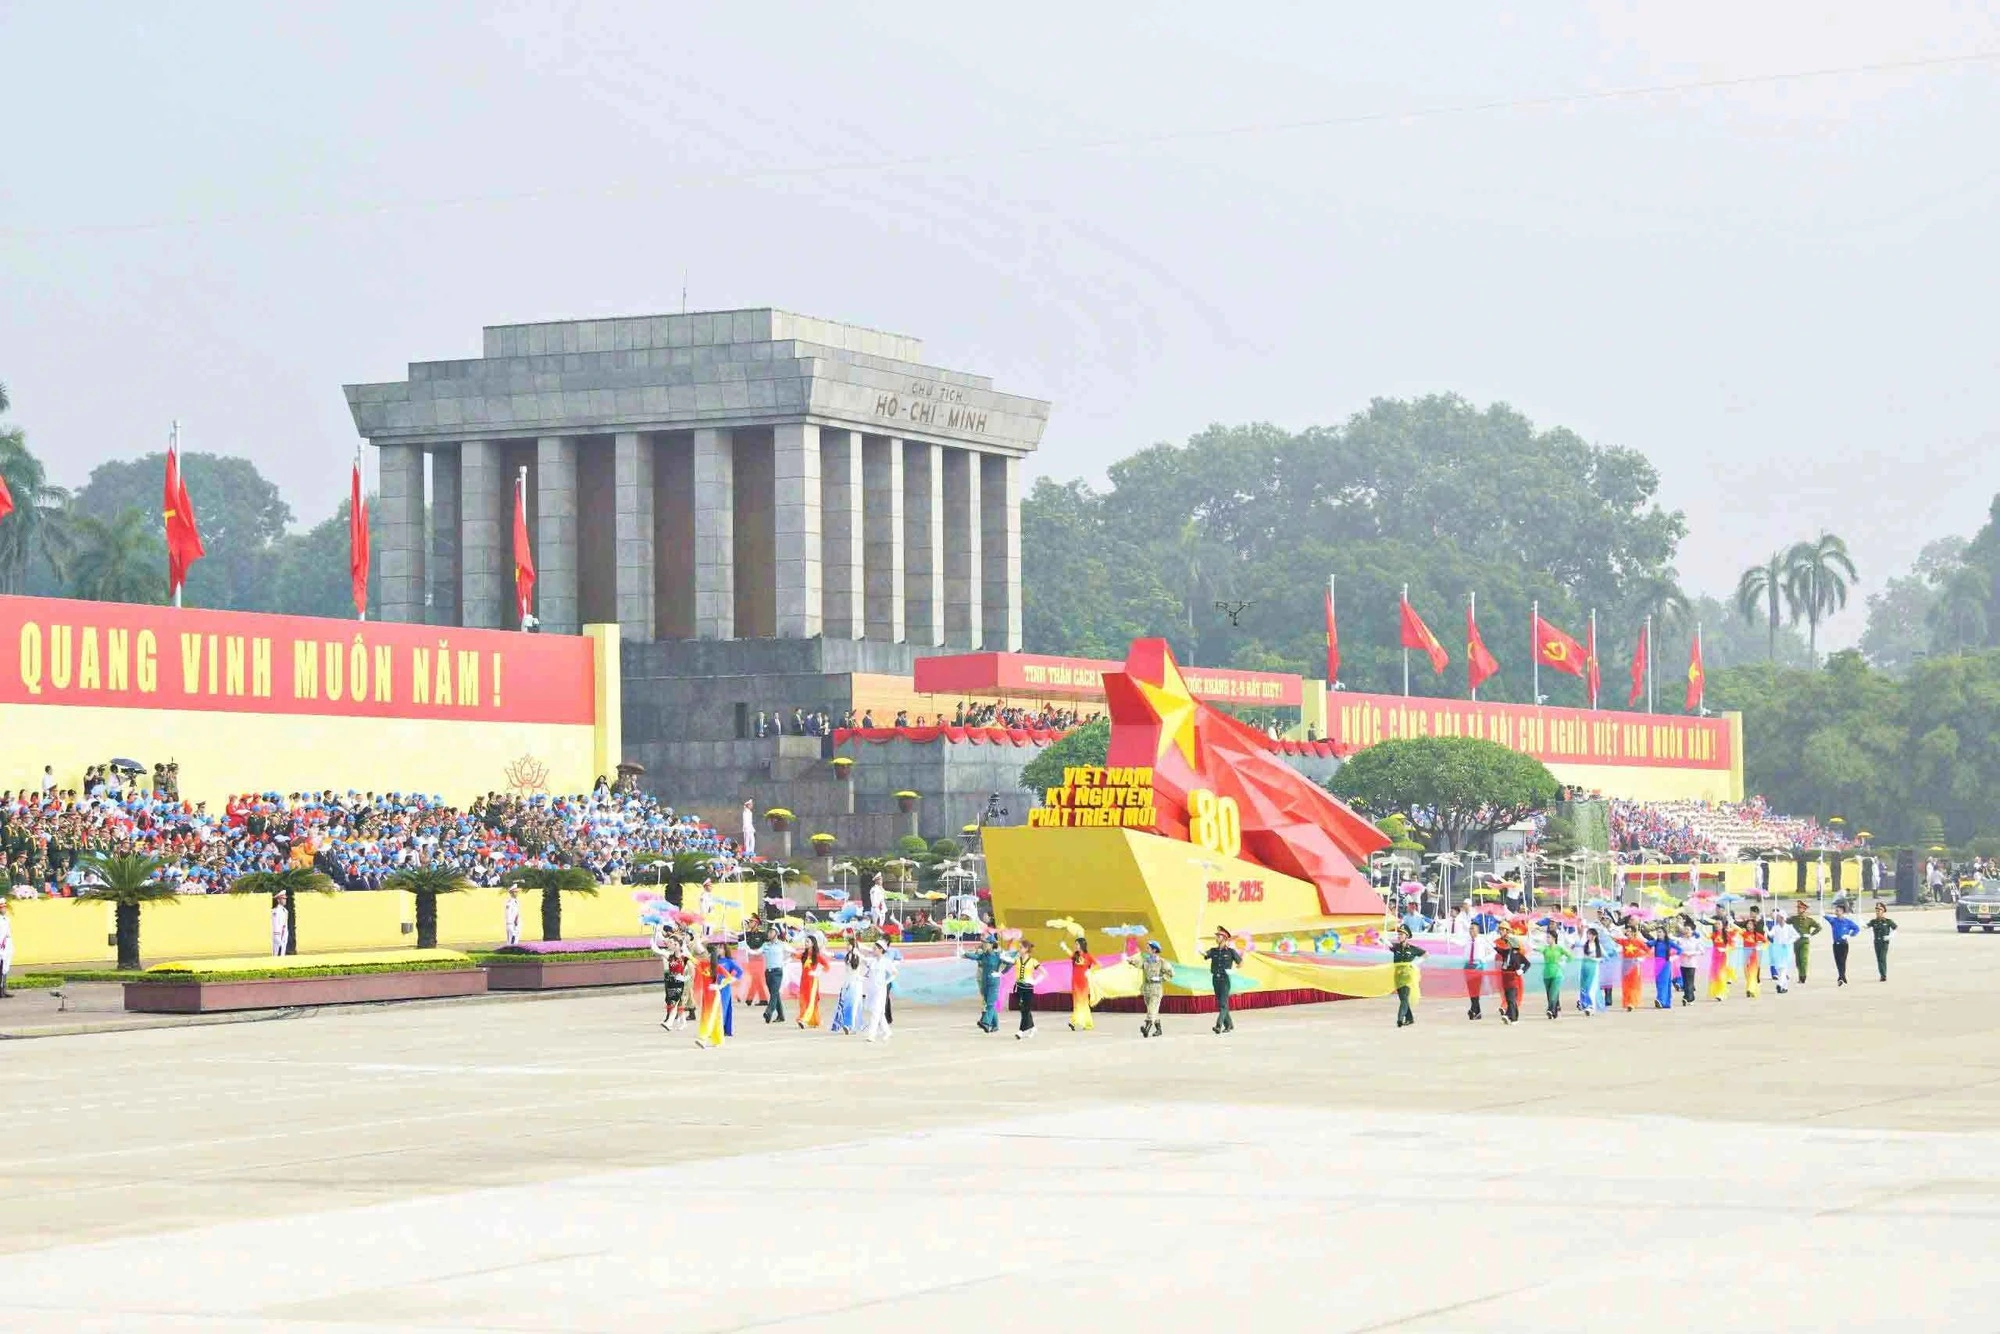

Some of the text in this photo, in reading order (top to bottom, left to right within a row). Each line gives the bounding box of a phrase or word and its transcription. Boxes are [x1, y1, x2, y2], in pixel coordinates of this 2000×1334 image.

[20, 621, 157, 695] QUANG
[180, 633, 271, 697] VINH
[294, 633, 392, 703] MUÔN
[412, 639, 479, 706] NĂM
[1341, 700, 1381, 745] NƯỚC
[1550, 715, 1588, 755] NGHĨA
[1593, 717, 1619, 763] VIỆT
[1623, 724, 1647, 758] NAM
[1652, 722, 1683, 760] MUÔN
[1688, 723, 1710, 761] NĂM
[1063, 764, 1153, 787] VIỆT NAM
[1074, 786, 1154, 809] NGUYÊN
[1187, 788, 1242, 858] 80
[1207, 881, 1231, 903] 1945
[1239, 880, 1264, 903] 2025
